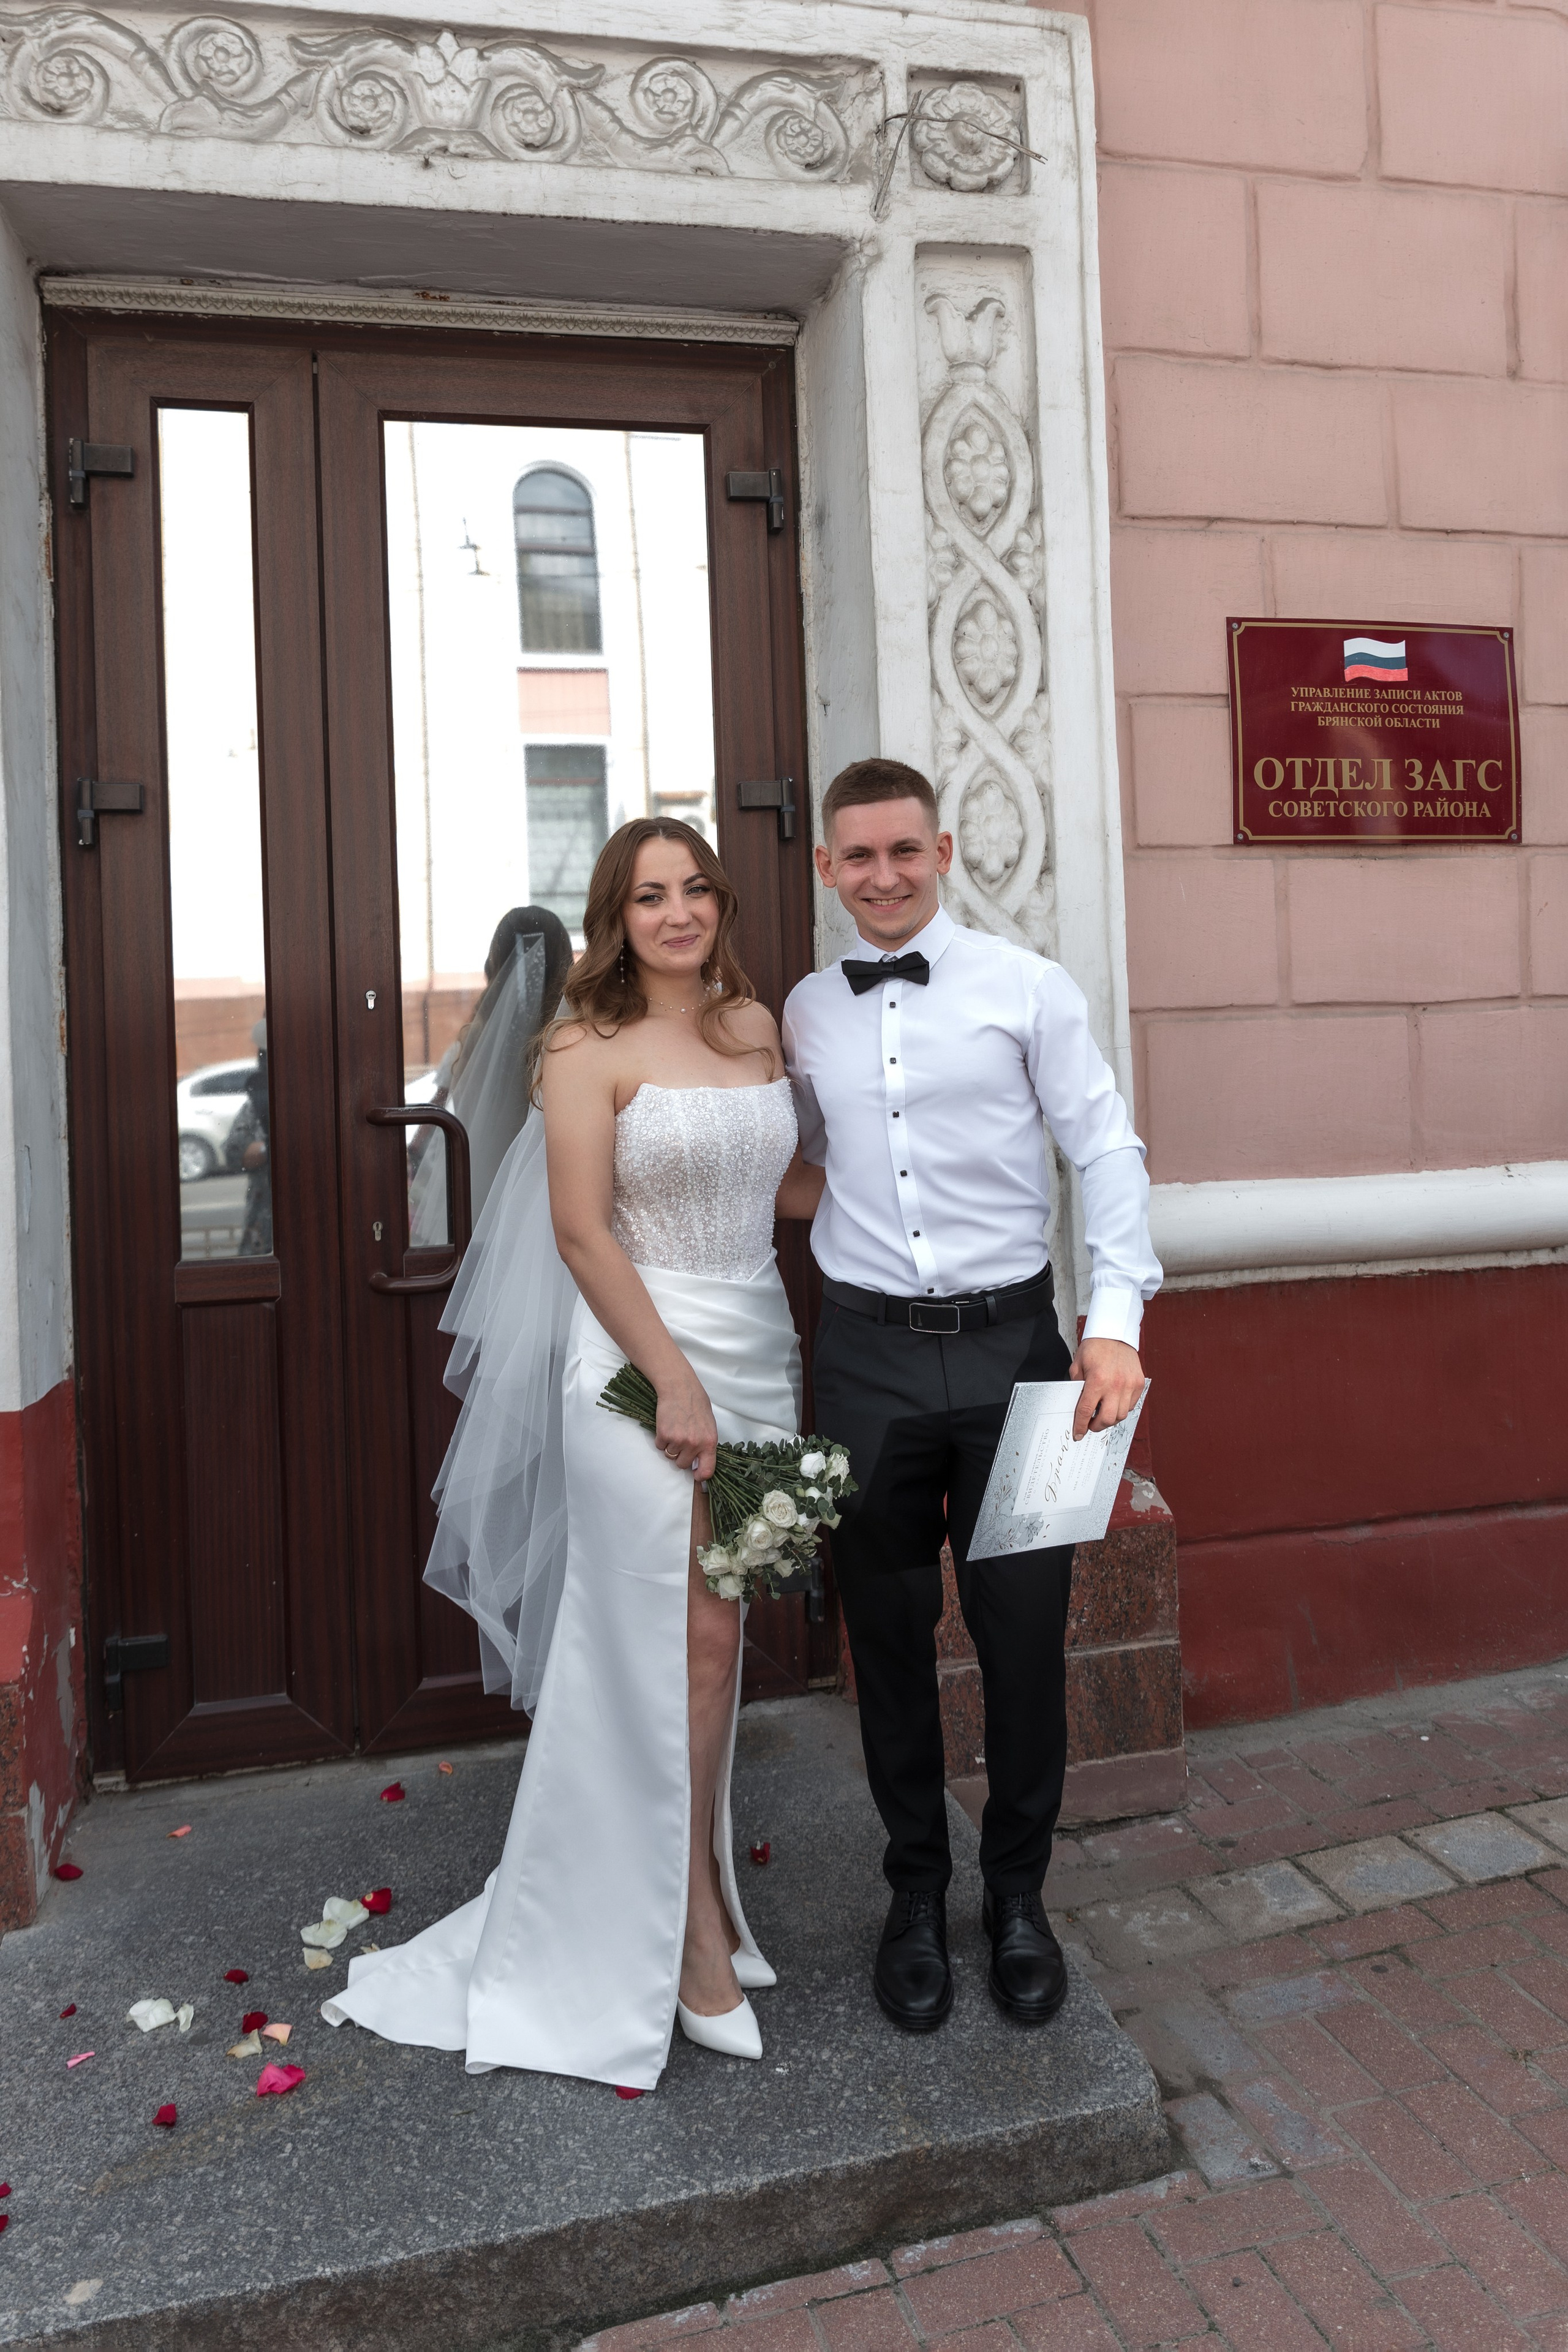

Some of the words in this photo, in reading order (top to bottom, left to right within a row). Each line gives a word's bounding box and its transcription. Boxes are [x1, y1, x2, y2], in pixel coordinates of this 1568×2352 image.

[1291, 687, 1371, 699] УПРАВЛЕНИЕ
[1374, 689, 1421, 700] ЗАПИСИ
[1423, 690, 1463, 701] АКТОВ
[1290, 701, 1389, 714] ГРАЖДАНСКОГО
[1392, 704, 1464, 715] СОСТОЯНИЯ
[1317, 715, 1382, 727] БРЯНСКОЙ
[1385, 717, 1440, 728] ОБЛАСТИ
[1254, 757, 1394, 798] ОТДЕЛ
[1404, 758, 1502, 791] ЗАГС
[1268, 801, 1408, 818] СОВЕТСКОГО
[1413, 797, 1491, 818] РАЙОНА
[1024, 1428, 1050, 1505] СВИДЕТЕЛЬСТВО
